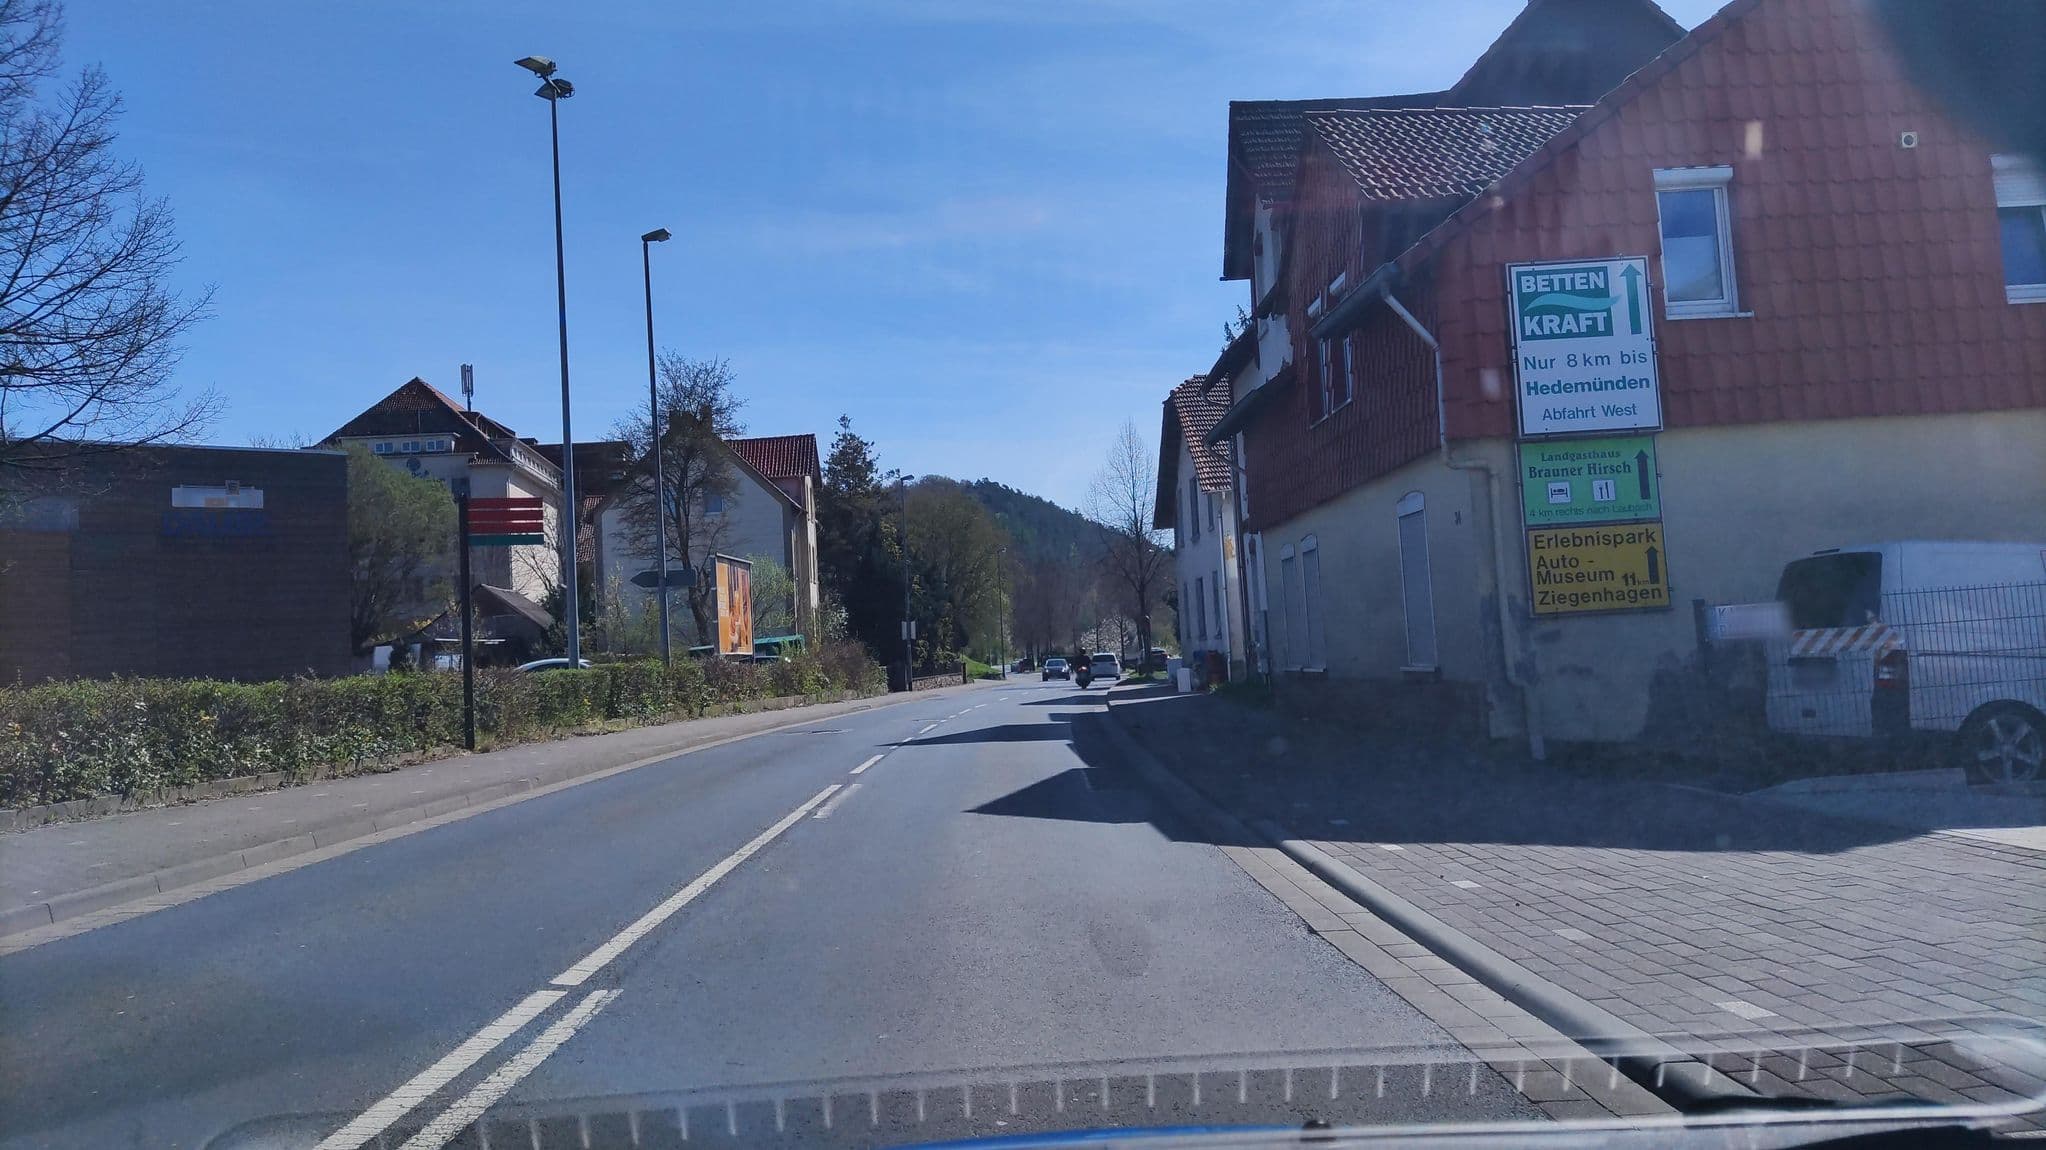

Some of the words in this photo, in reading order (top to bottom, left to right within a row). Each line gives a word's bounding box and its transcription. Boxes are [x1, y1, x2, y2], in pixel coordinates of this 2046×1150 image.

[1520, 271, 1605, 293] BETTEN
[1523, 311, 1608, 336] KRAFT
[1524, 356, 1556, 370] Nur
[1566, 353, 1578, 368] 8
[1582, 353, 1611, 367] km
[1620, 350, 1648, 365] bis
[1525, 375, 1650, 396] Hedemünden
[1542, 405, 1596, 421] Abfahrt
[1601, 403, 1638, 418] West
[1541, 450, 1622, 462] Landgasthaus
[1528, 465, 1583, 479] Brauner
[1587, 460, 1632, 475] Hirsch
[1533, 527, 1657, 550] Erlebnispark
[1536, 554, 1580, 570] Auto
[1536, 569, 1615, 586] Museum
[1621, 571, 1637, 587] 11
[1538, 586, 1663, 607] Ziegenhagen
